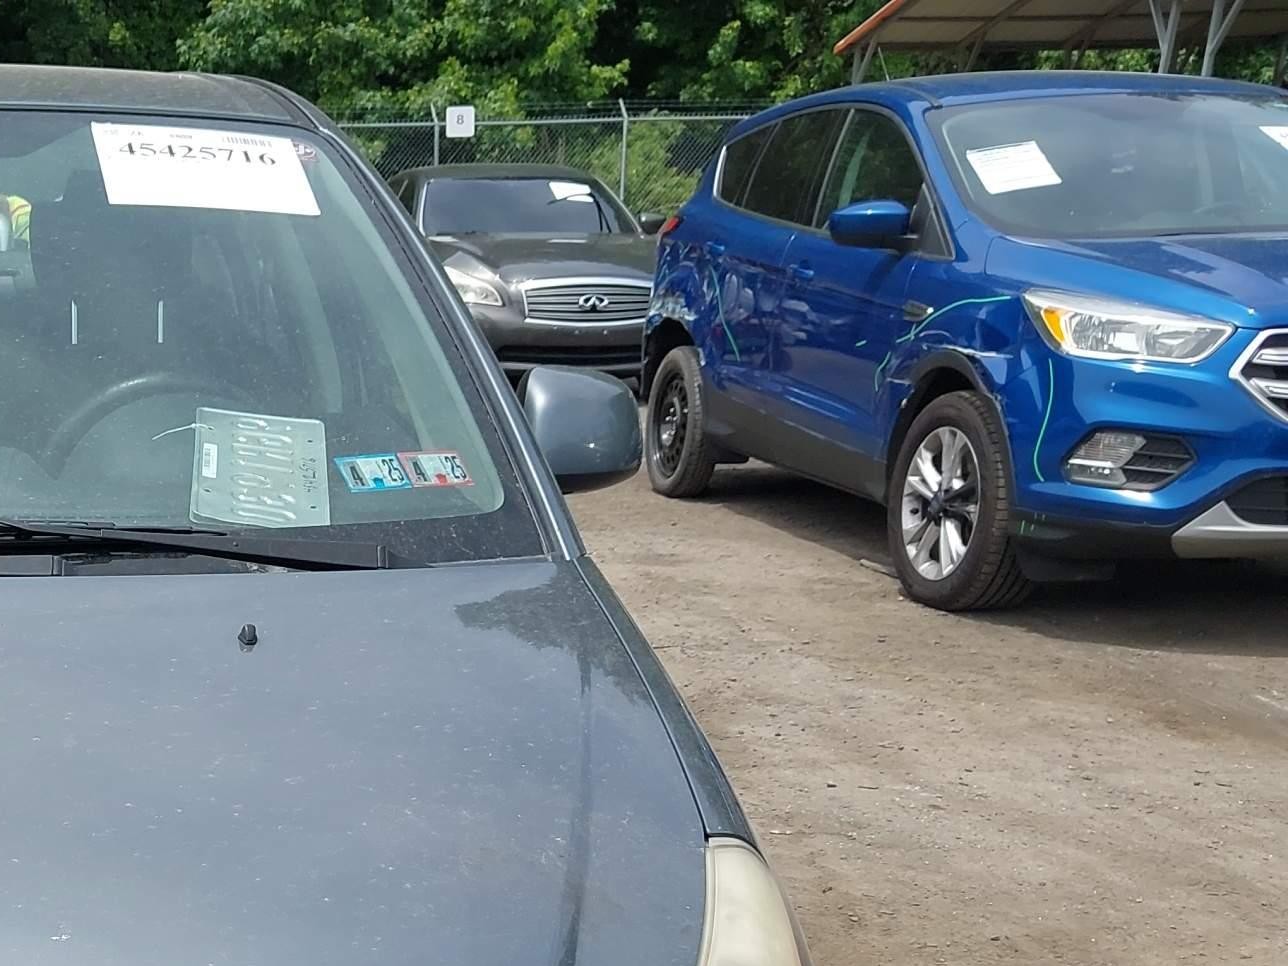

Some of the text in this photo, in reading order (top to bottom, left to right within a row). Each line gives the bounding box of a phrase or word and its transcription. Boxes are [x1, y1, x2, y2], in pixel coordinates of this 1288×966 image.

[455, 114, 465, 125] 8
[119, 141, 276, 166] 45425716
[349, 458, 405, 487] 4 25
[412, 455, 468, 482] 4 25
